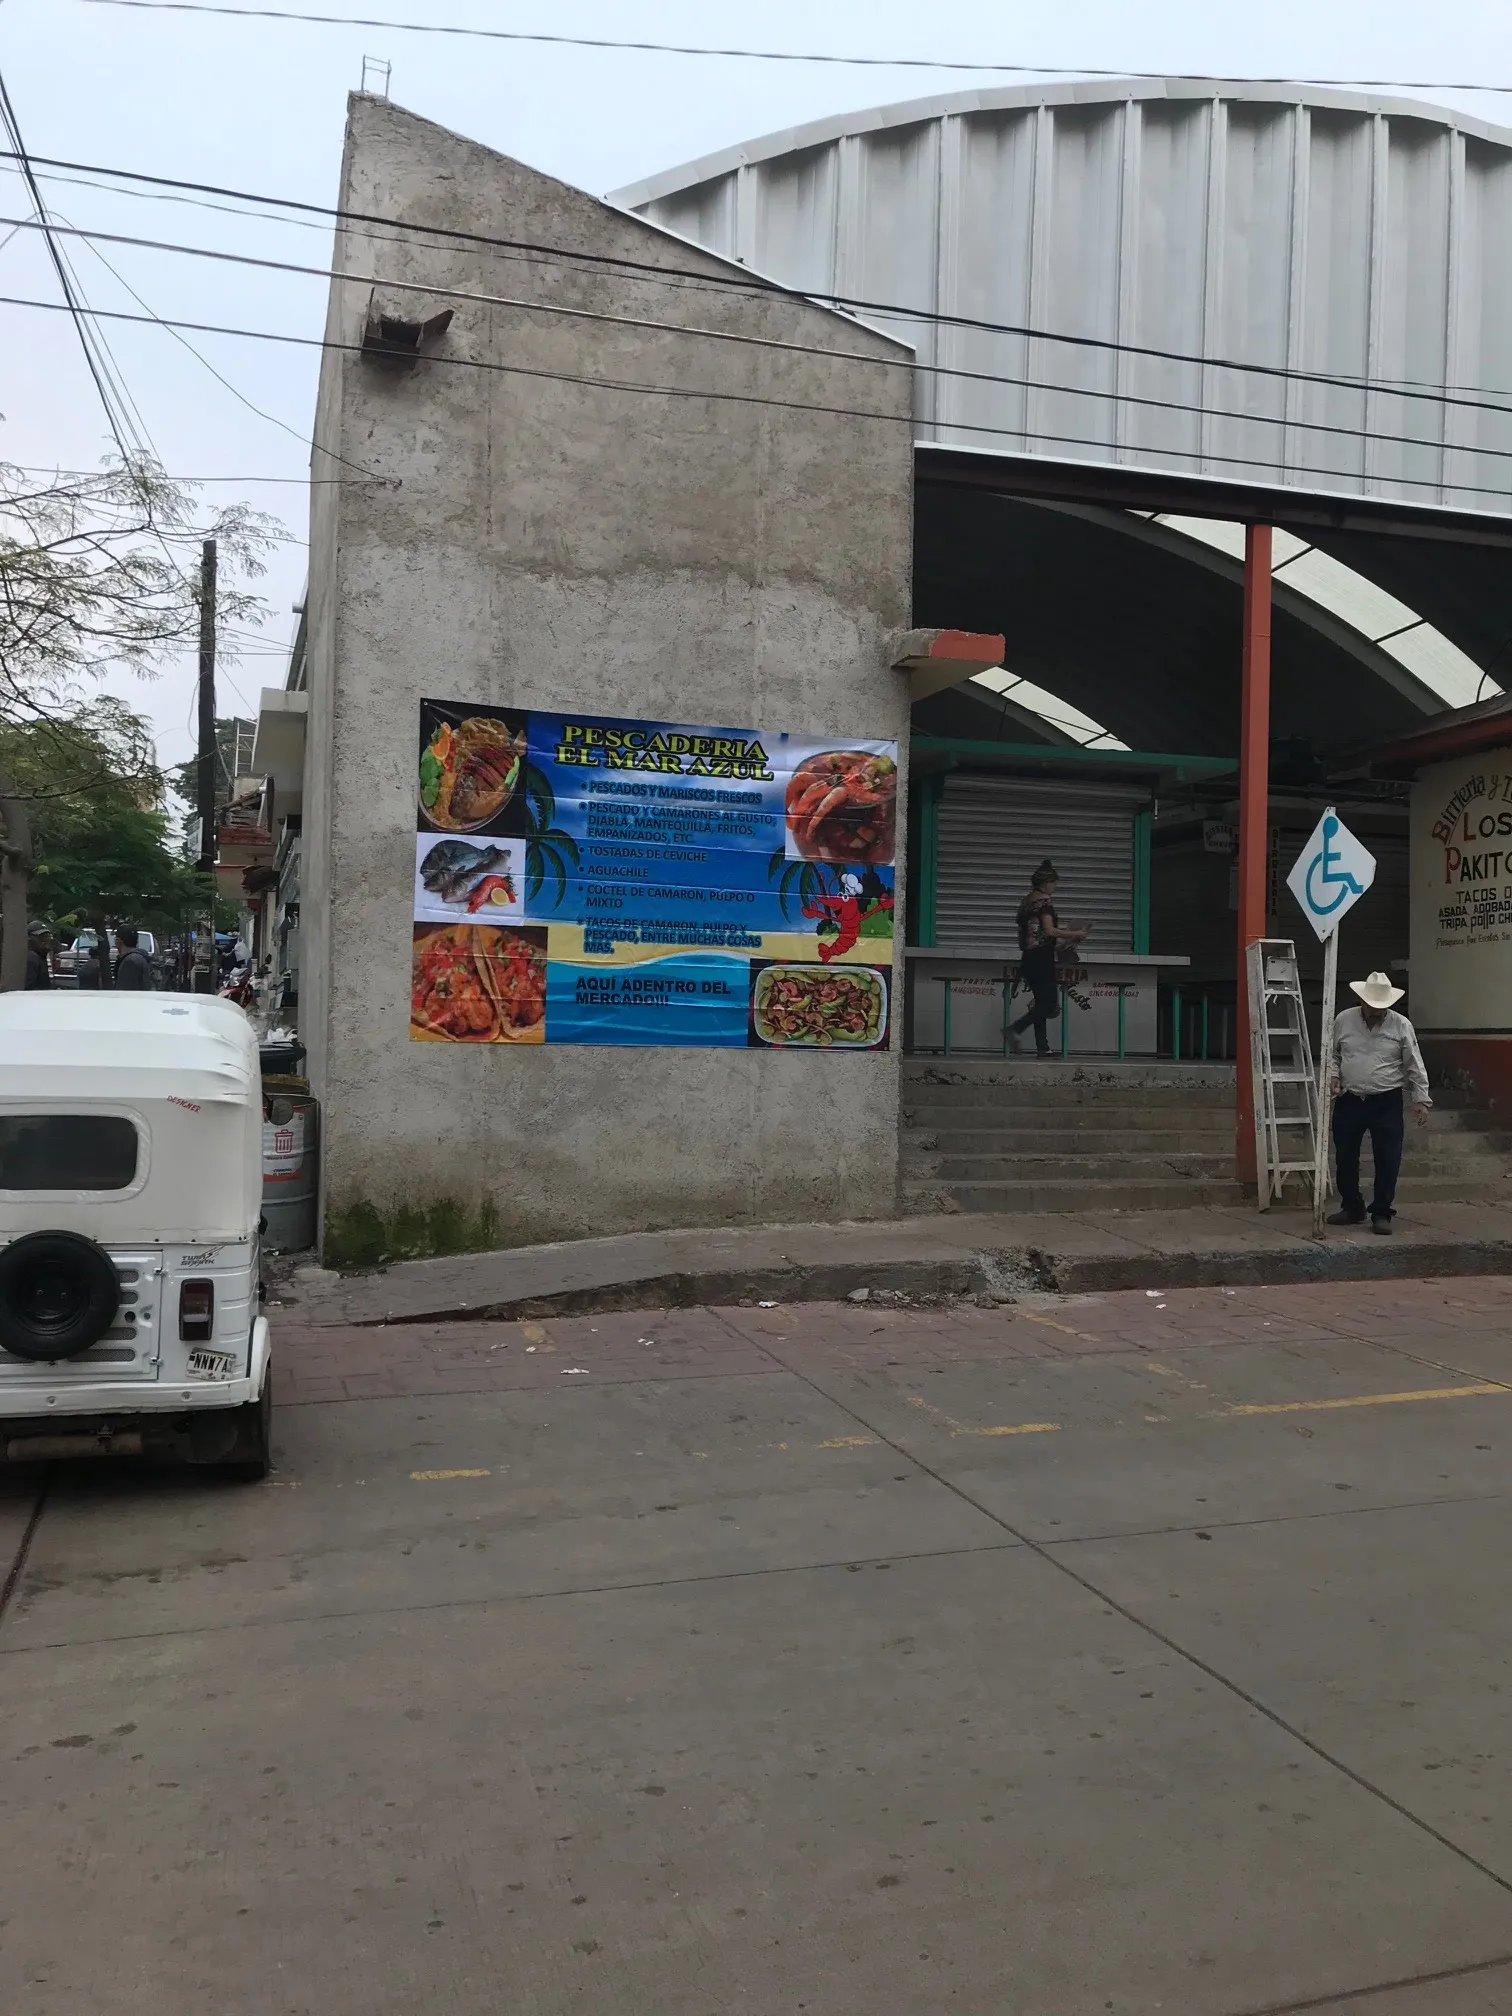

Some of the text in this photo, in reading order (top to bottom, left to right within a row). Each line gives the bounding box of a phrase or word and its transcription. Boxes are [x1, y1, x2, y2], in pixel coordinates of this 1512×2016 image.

[562, 725, 769, 761] PESCADERIA
[555, 744, 774, 781] EL MAR AZUL
[589, 781, 762, 803] PESCADOS Y MARISCOS FRESCOS
[589, 803, 639, 815] PESCADO
[642, 806, 649, 816] Y
[652, 806, 720, 820] CAMARONES
[722, 811, 734, 822] AL
[634, 820, 714, 834] MANTEQUILLA,
[718, 824, 756, 836] FRITOS,
[1464, 812, 1512, 842] LOS
[588, 828, 694, 844] EMPANIZADOS, ETC.
[588, 846, 707, 862] TOSTADAS DE CEVICHE
[588, 864, 648, 877] AGUACHILE
[587, 884, 755, 902] COCTEL DE CAMARON, PULPO O
[1456, 888, 1496, 904] TACOS
[586, 898, 622, 908] MIXTO
[586, 916, 620, 928] TACOS
[624, 918, 638, 928] DE
[703, 922, 737, 933] PULPO
[584, 929, 761, 947] PESCADO, ENTRE MUCHAS COSAS
[584, 942, 614, 954] MAS.
[622, 979, 696, 993] ADENTRO
[702, 982, 731, 994] DEL
[576, 992, 668, 1006] MERCADO!!!
[167, 1095, 201, 1114] DESIGNER
